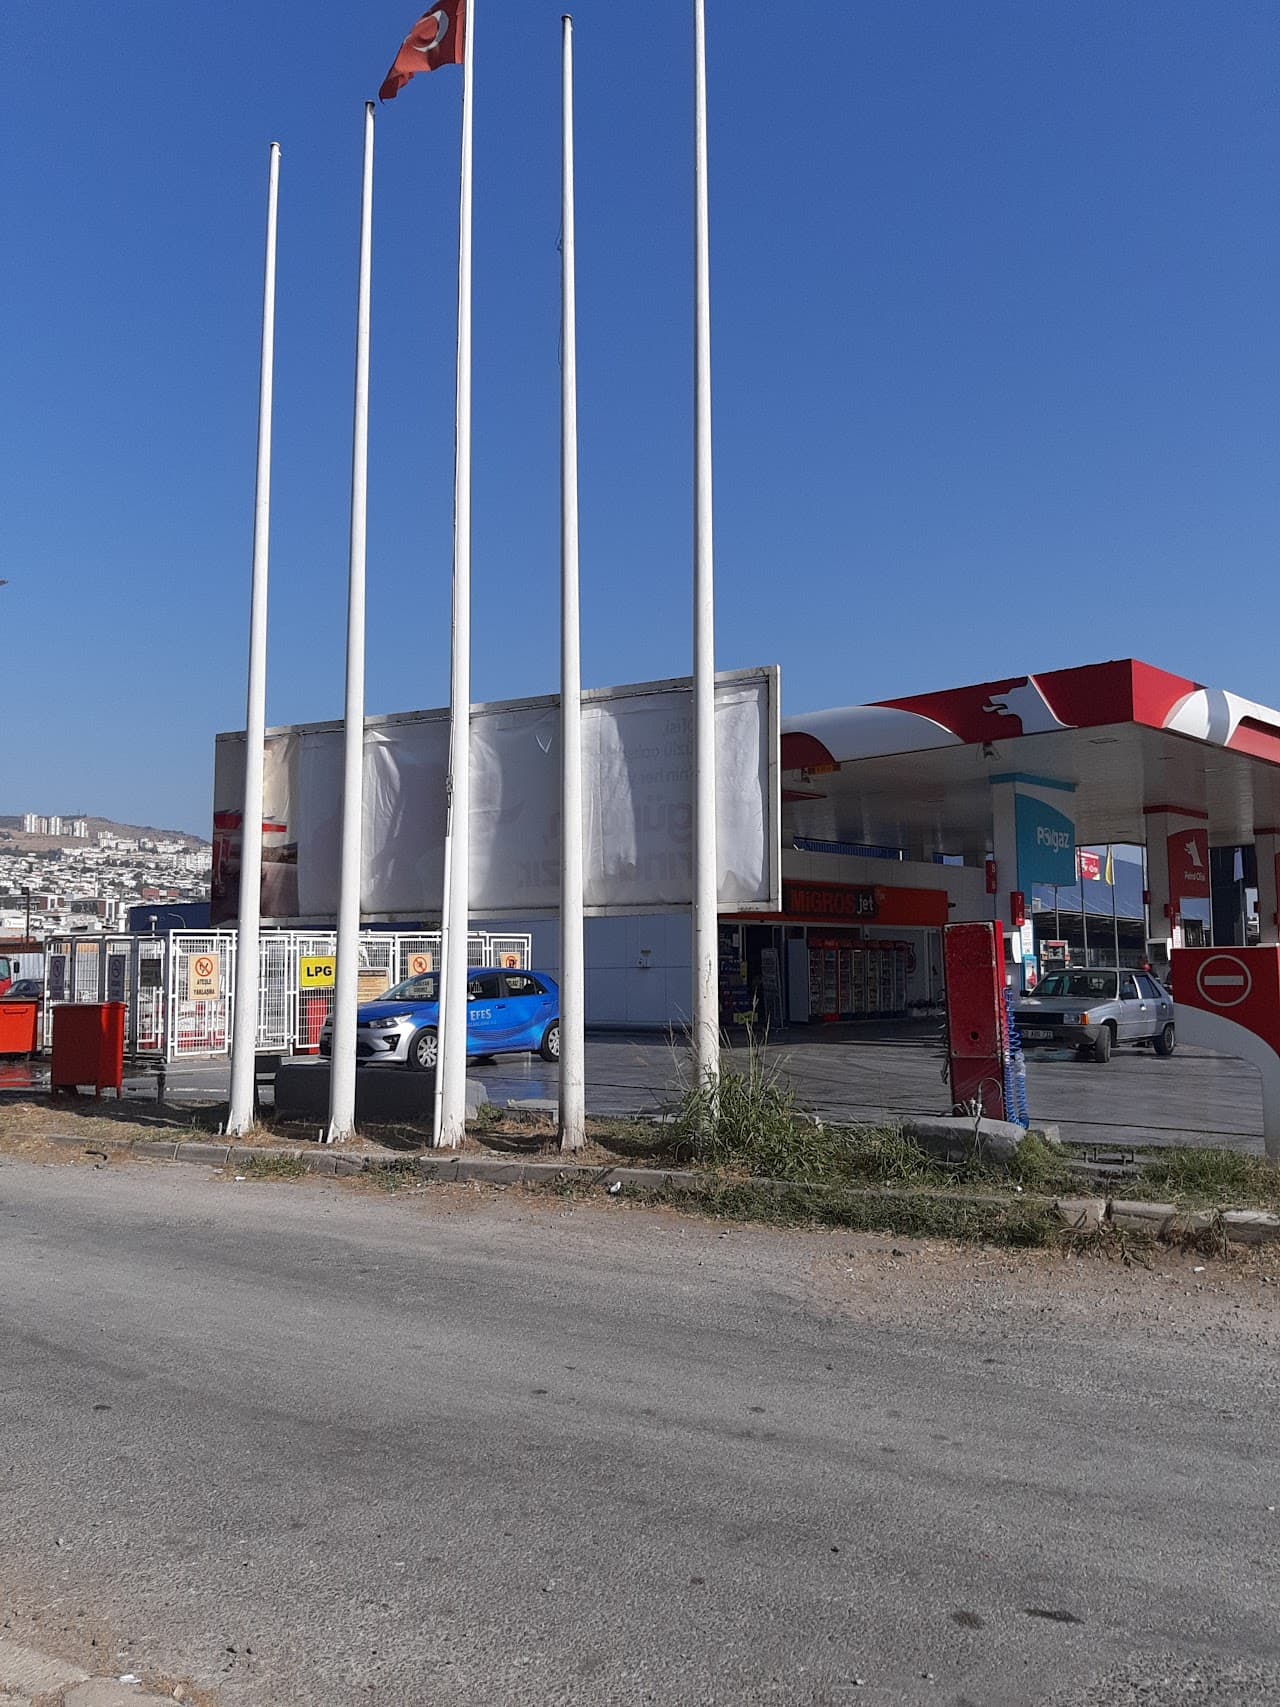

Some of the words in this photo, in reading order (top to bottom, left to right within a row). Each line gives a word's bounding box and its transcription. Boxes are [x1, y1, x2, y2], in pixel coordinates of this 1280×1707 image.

[856, 893, 874, 915] jet
[306, 965, 333, 977] LPG
[470, 1008, 493, 1021] EFES
